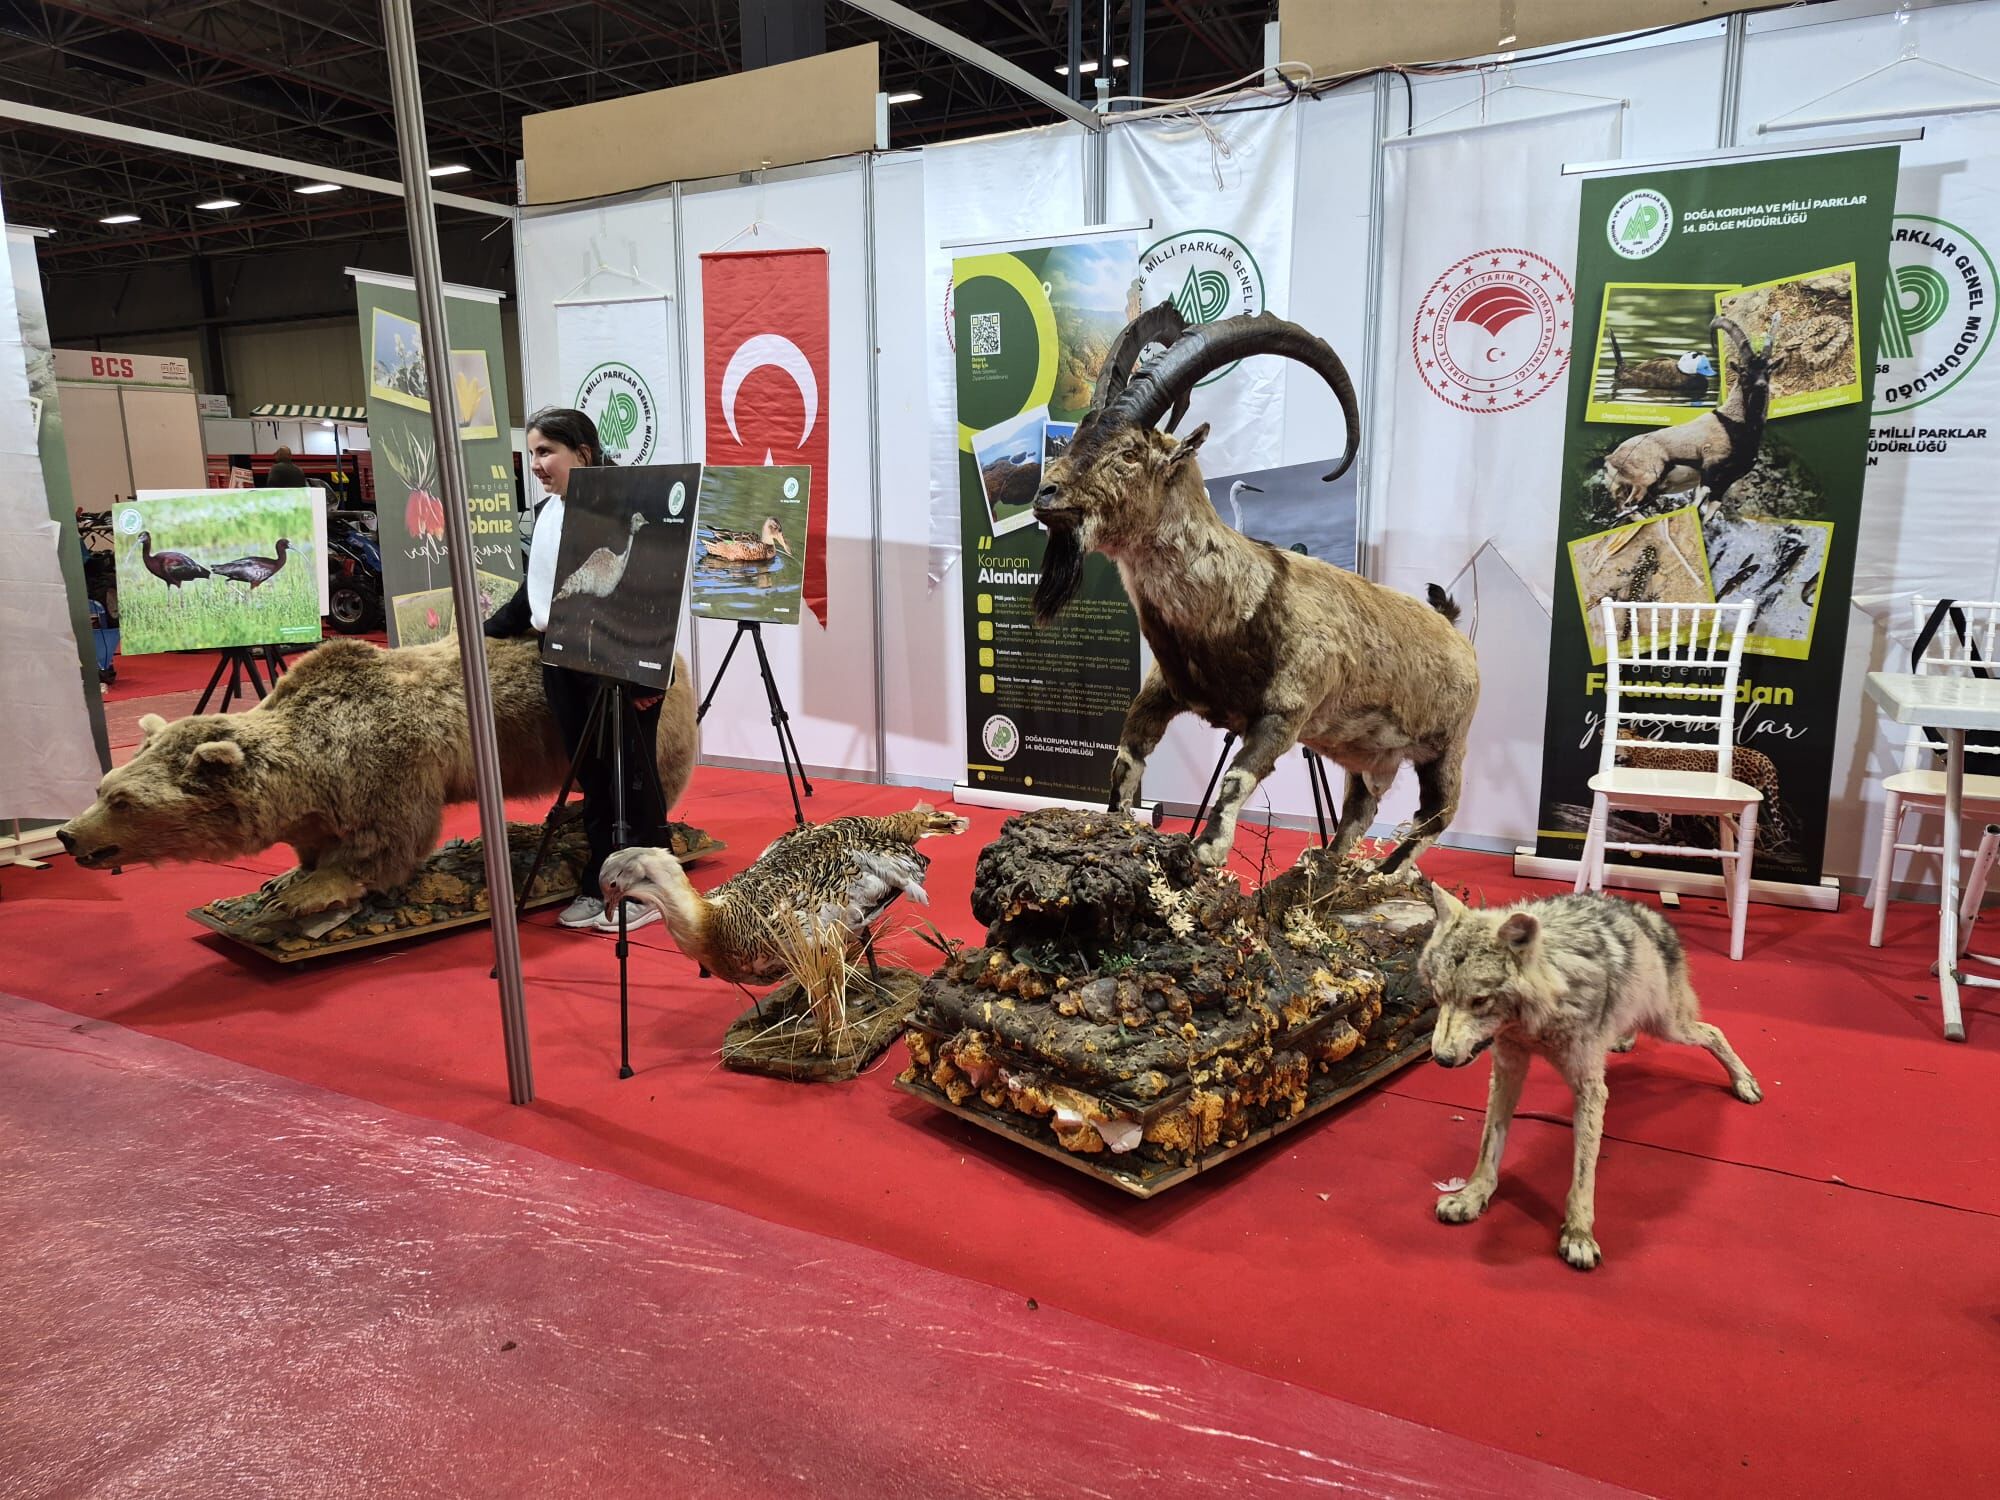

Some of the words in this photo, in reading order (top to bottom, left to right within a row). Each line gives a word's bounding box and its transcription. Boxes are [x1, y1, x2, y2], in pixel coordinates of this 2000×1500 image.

[1684, 207, 1714, 222] DOĞA
[1716, 205, 1765, 218] KORUMA
[1766, 204, 1780, 214] VE
[1782, 198, 1812, 212] MİLLİ
[1813, 195, 1868, 209] PARKLAR
[1682, 224, 1698, 234] 14.
[1699, 218, 1735, 232] BÖLGE
[1736, 214, 1808, 230] MÜDÜRLÜĞÜ
[1890, 228, 1957, 257] RKLAR
[1145, 245, 1176, 273] MİLLİ
[1180, 241, 1234, 262] PARKLAR
[1232, 260, 1253, 304] GENEL
[1481, 273, 1514, 284] TARIM
[1518, 278, 1530, 288] VE
[1955, 255, 1984, 310] GENEL
[1436, 280, 1477, 346] CUMHURİYETİ
[1532, 287, 1552, 322] ORMAN
[1514, 328, 1553, 381] BAKANLIĞI
[1885, 316, 1982, 403] MÜDÜRLÜĞÜ
[91, 356, 134, 378] BCS
[1439, 352, 1470, 385] TÜRKİYE
[586, 373, 602, 396] MİLLİ
[604, 370, 638, 390] PARKLAR
[580, 397, 588, 409] VE
[636, 388, 651, 422] GENEL
[1879, 426, 1916, 438] MİLLİ
[1918, 428, 1987, 438] PARKLAR
[630, 425, 652, 466] MÜDÜRL
[1868, 440, 1947, 452] ÜDÜRLÜĞÜ
[978, 554, 1030, 568] Korunan
[978, 568, 1042, 585] Alanları
[1034, 744, 1054, 752] BÖLGE
[1054, 746, 1094, 756] MÜDÜRLÜĞÜ
[1042, 736, 1070, 746] KORUMA
[1079, 740, 1096, 748] MİLLİ
[1096, 742, 1121, 751] PARKLA
